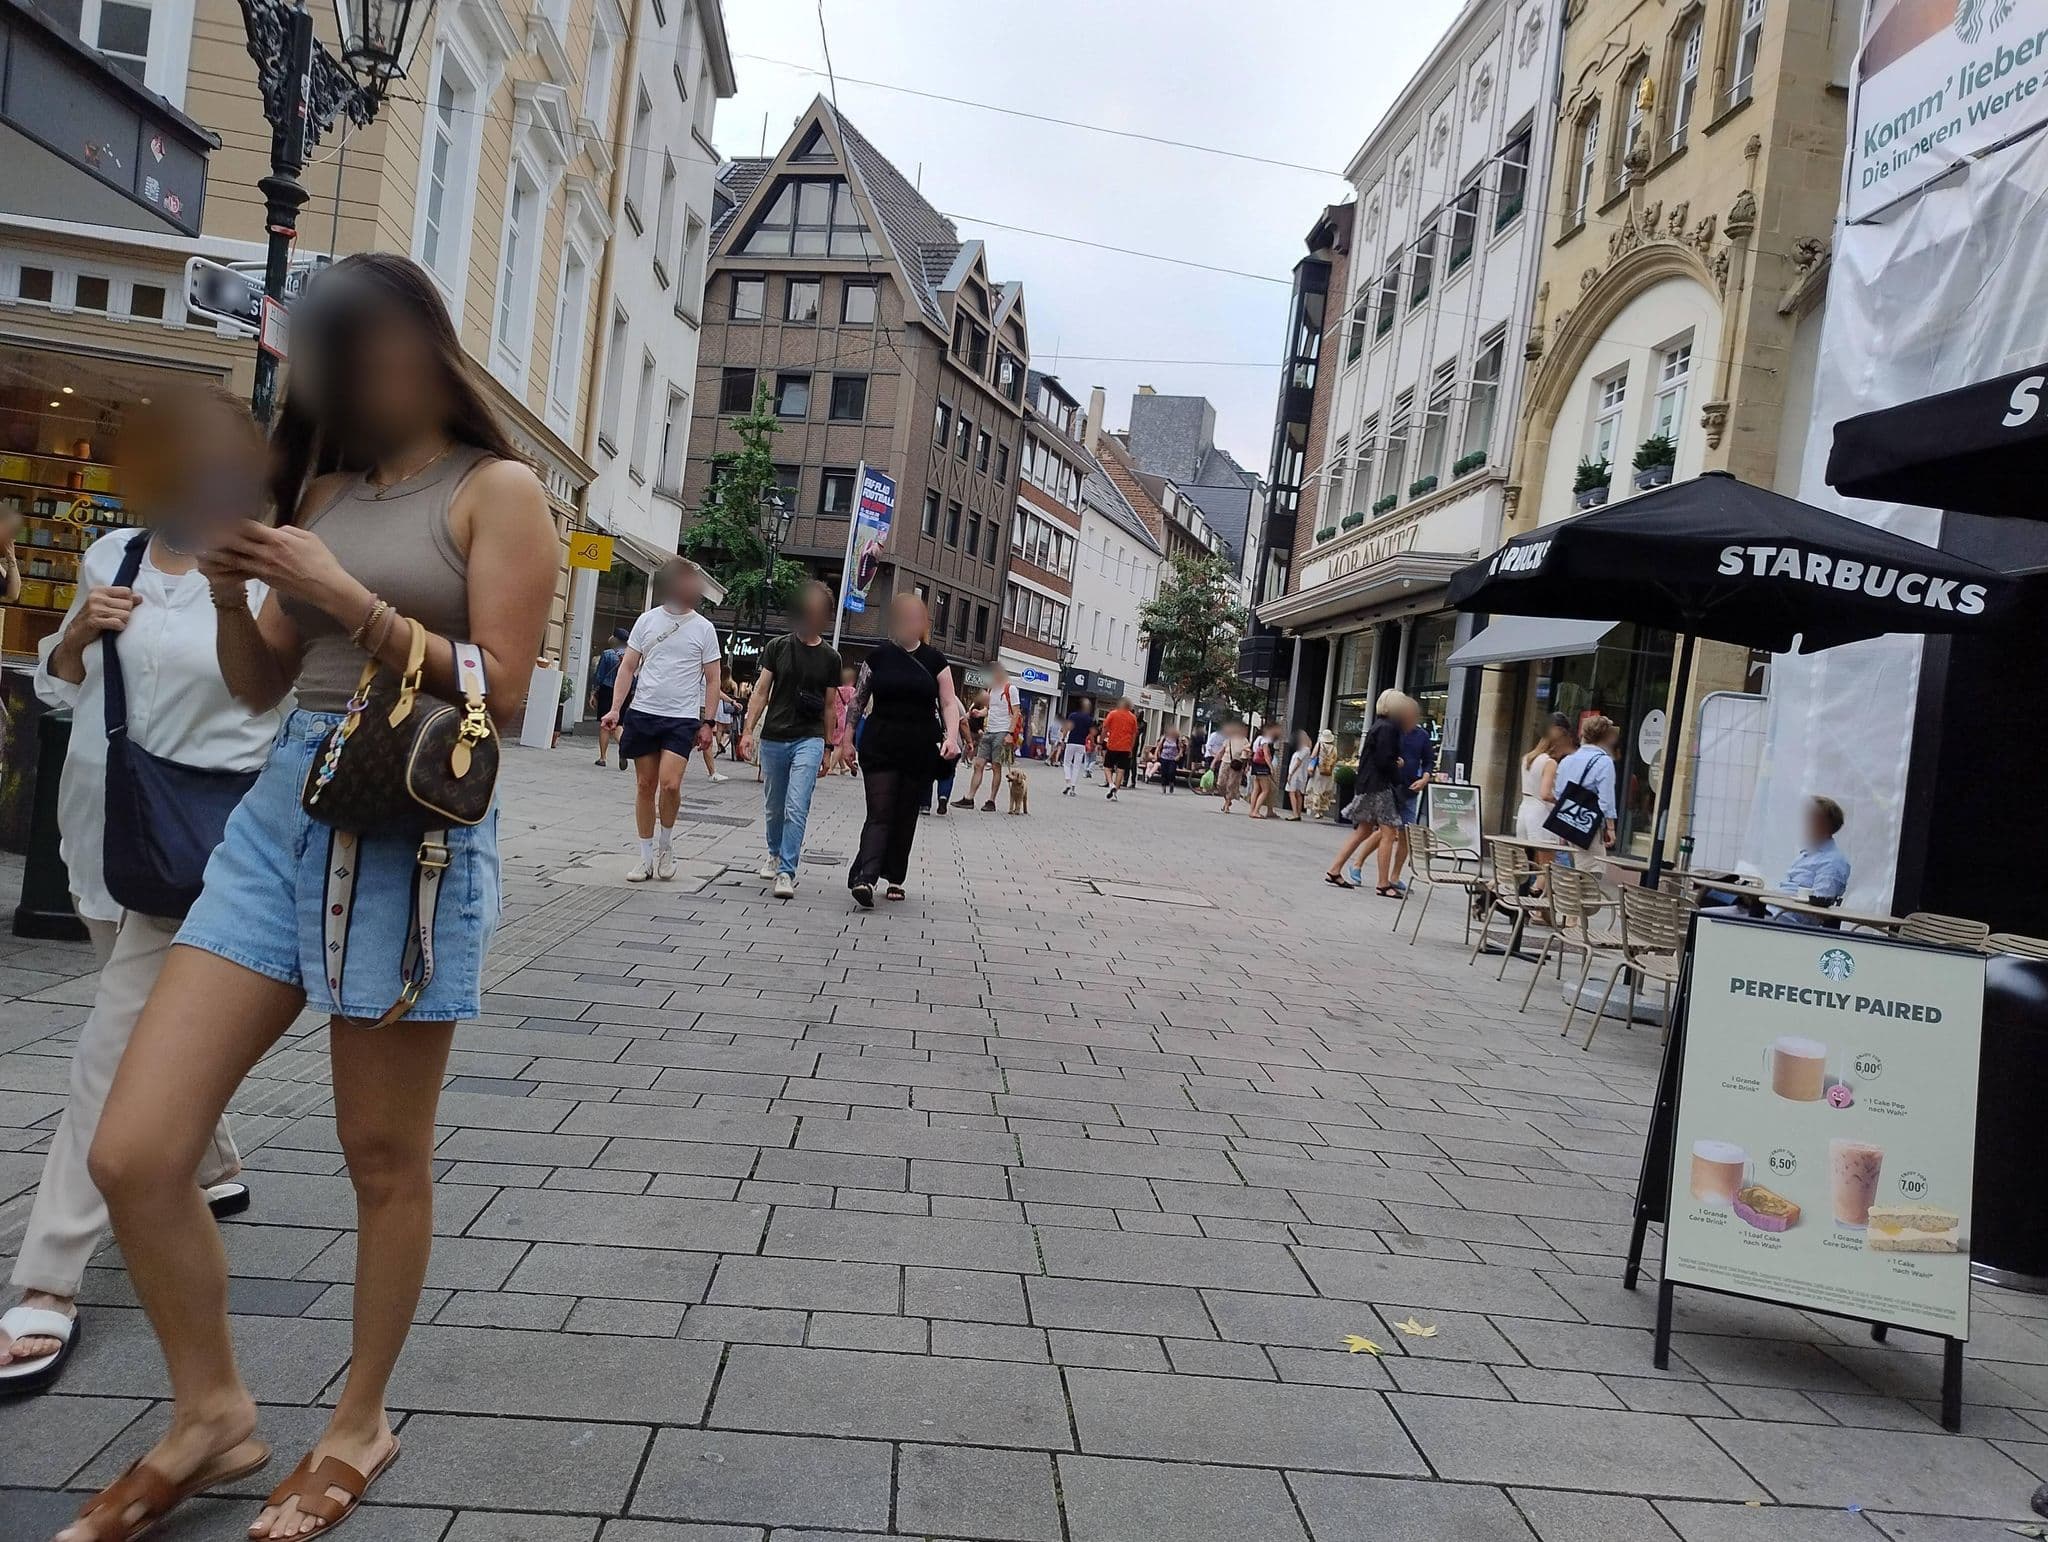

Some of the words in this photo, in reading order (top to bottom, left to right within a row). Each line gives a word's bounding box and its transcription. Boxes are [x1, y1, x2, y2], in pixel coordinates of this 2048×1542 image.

[1862, 160, 1889, 189] Die
[1893, 117, 1962, 172] inneren
[1968, 76, 2039, 127] Werte
[1327, 524, 1419, 581] MORAWITZ
[1717, 545, 1988, 615] STARBUCKS
[1729, 977, 1851, 1010] PERFECTLY
[1854, 995, 1943, 1024] PAIRED
[1735, 1076, 1760, 1086] Grande
[1873, 1098, 1891, 1107] Cake
[1891, 1101, 1905, 1110] Pop
[1868, 1106, 1885, 1114] nach
[1703, 1209, 1728, 1219] Grande
[1743, 1238, 1760, 1247] nach
[1763, 1234, 1781, 1243] Cake
[1837, 1233, 1863, 1244] Grande
[1897, 1259, 1916, 1268] Cake
[1892, 1267, 1911, 1276] nach
